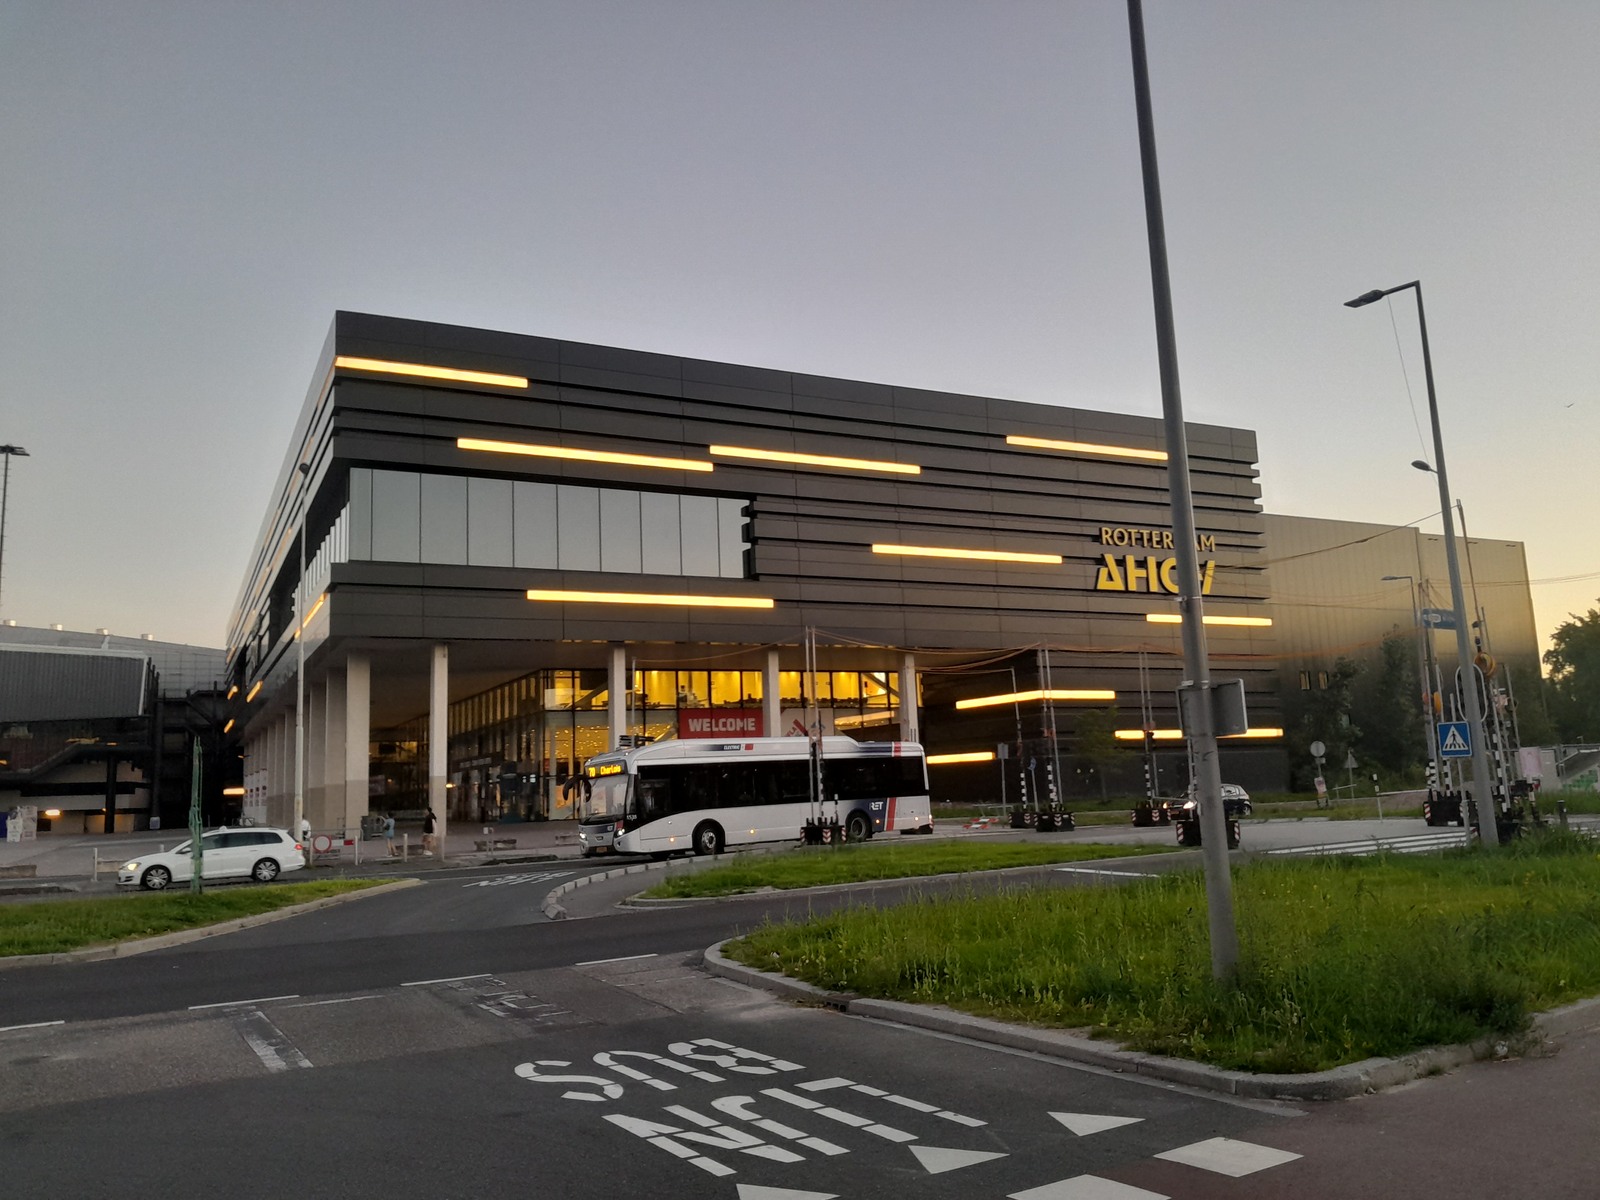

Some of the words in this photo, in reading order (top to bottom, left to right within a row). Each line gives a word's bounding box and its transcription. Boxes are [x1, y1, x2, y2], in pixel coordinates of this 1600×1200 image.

[1101, 527, 1216, 552] ROTTERM
[688, 718, 756, 732] WELCOME
[588, 767, 596, 777] 70
[869, 801, 884, 810] RET
[514, 1038, 806, 1101] BUS
[602, 1077, 988, 1176] LIJN
